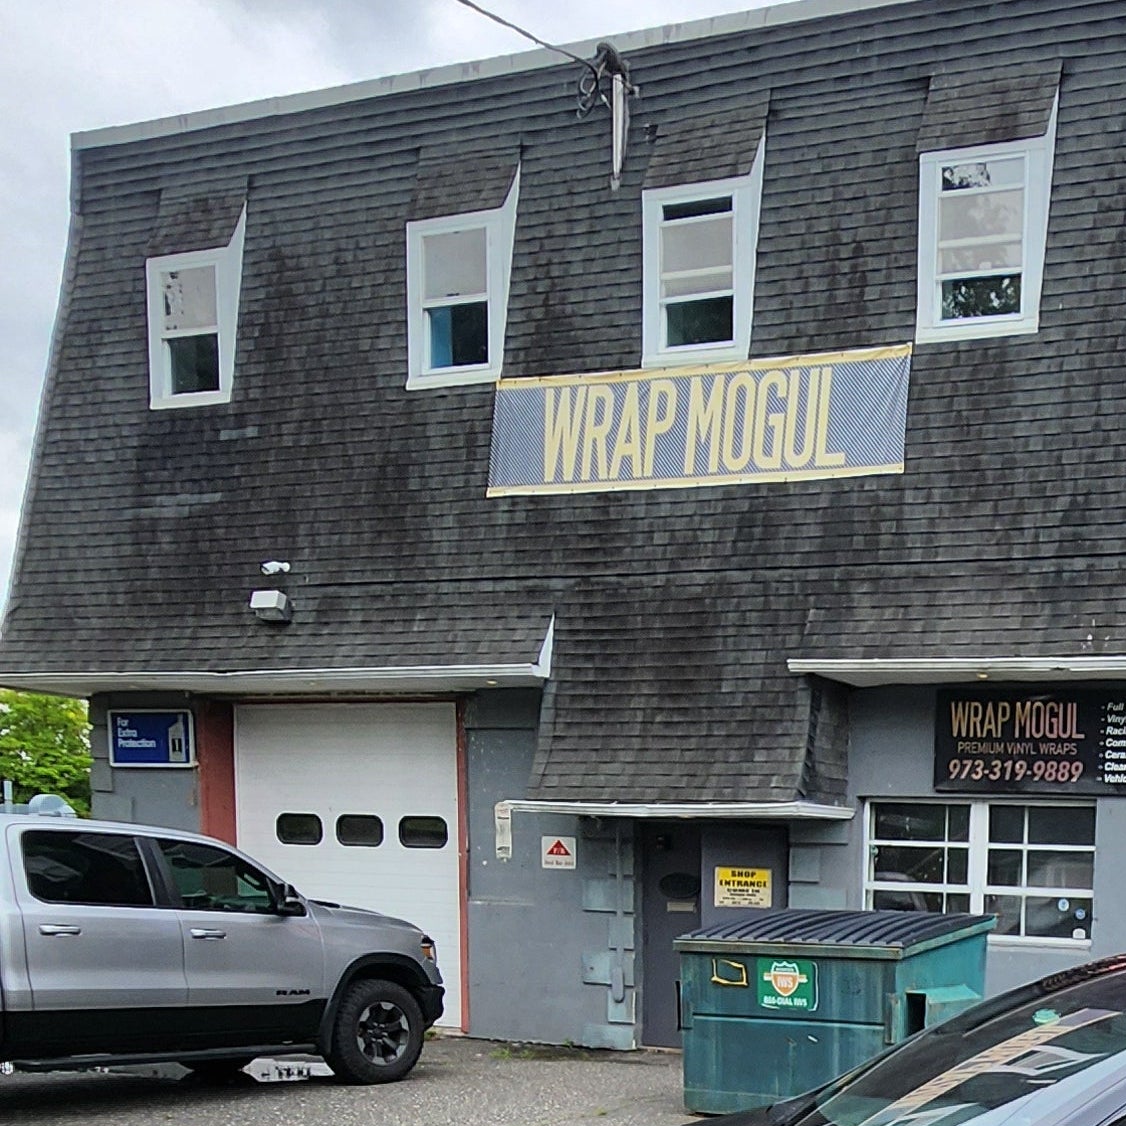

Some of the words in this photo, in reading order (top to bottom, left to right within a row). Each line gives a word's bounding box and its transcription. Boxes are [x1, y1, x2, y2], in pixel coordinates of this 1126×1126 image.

[543, 378, 678, 483] WRAP
[683, 366, 845, 475] MOGUL
[1107, 702, 1124, 711] Full
[951, 701, 1010, 738] WRAP
[1014, 701, 1085, 739] MOGUL
[958, 741, 1004, 754] PREMIUM
[1006, 742, 1037, 755] VINYL
[1039, 742, 1078, 755] WRAPS
[948, 759, 1084, 782] 973-319-9889
[731, 870, 757, 878] SHOP
[719, 879, 767, 888] ENTRANCE
